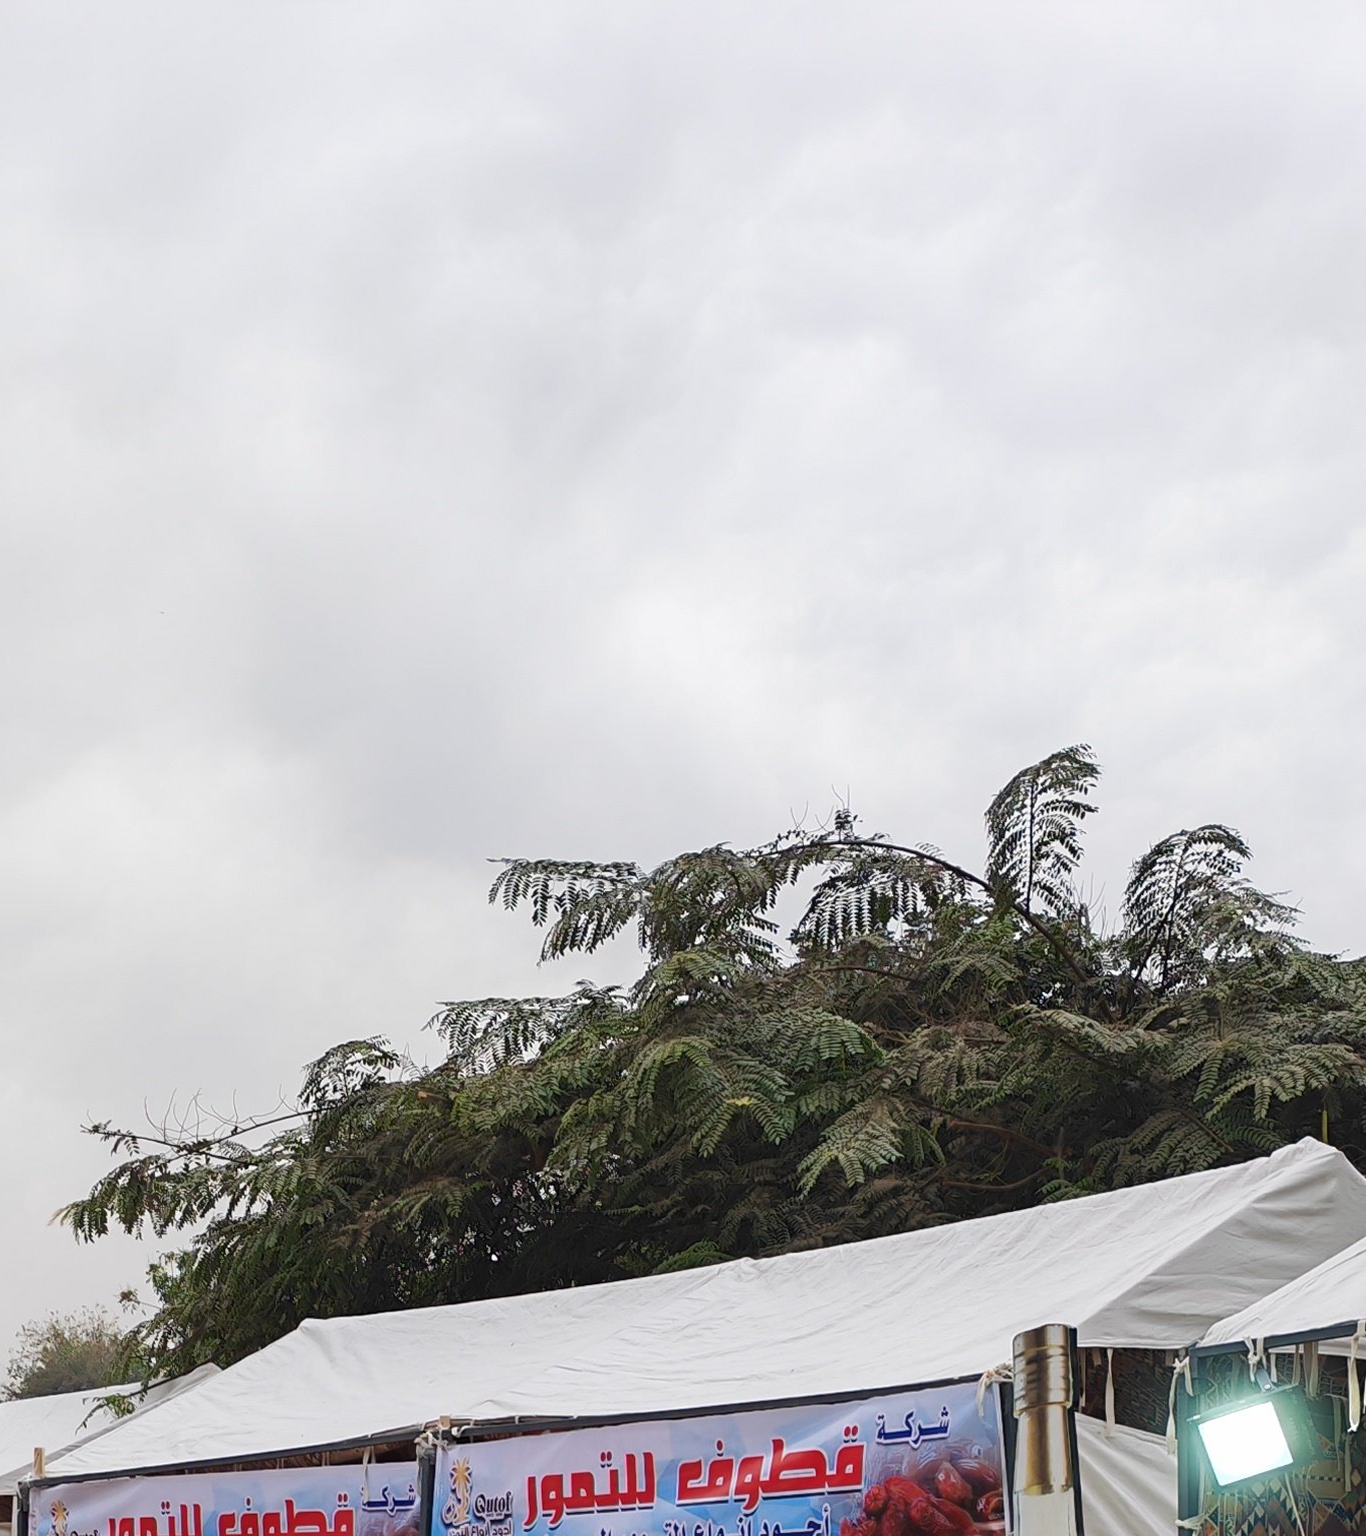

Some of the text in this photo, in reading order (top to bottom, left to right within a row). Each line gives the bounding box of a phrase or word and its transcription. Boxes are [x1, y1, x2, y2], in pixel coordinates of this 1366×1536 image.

[876, 1404, 951, 1450] شركة
[523, 1424, 866, 1532] قطوف للتمور
[475, 1490, 513, 1514] Qutof
